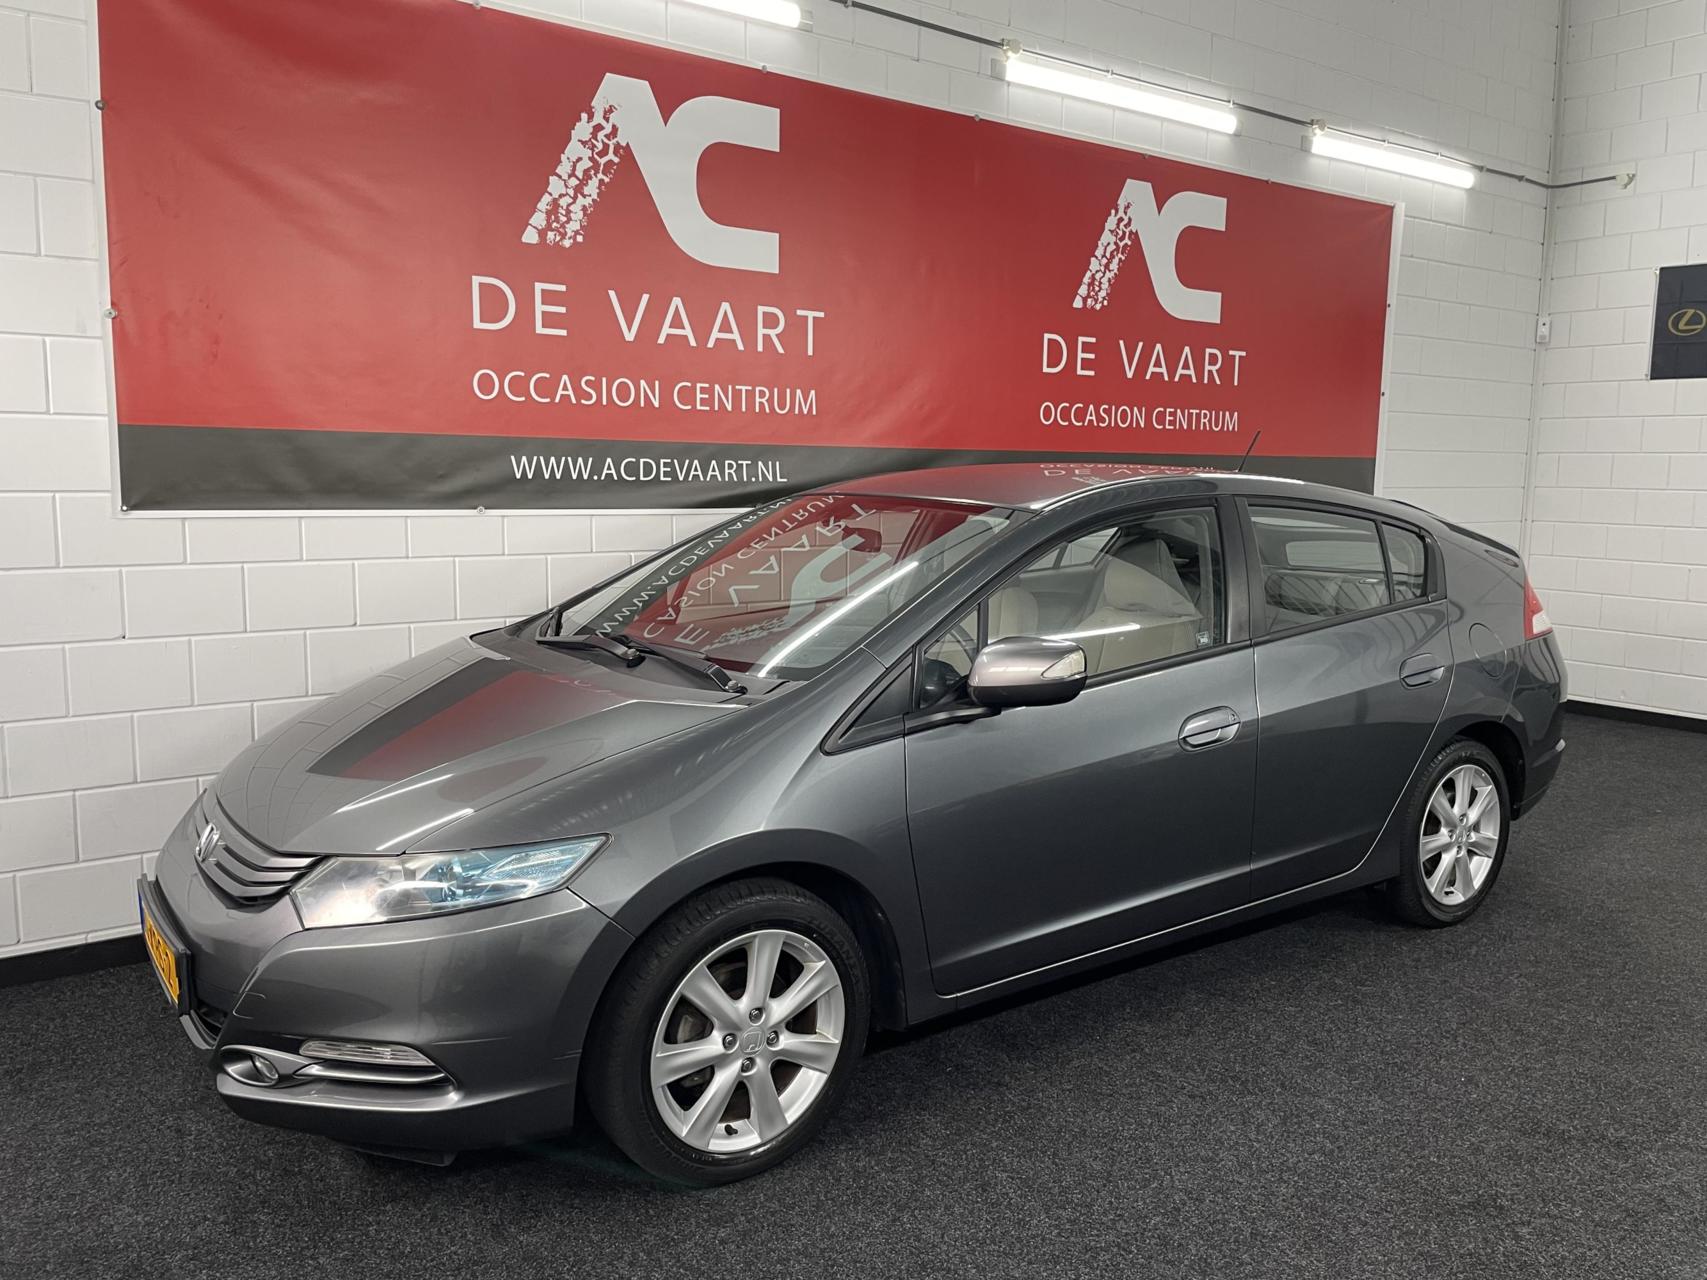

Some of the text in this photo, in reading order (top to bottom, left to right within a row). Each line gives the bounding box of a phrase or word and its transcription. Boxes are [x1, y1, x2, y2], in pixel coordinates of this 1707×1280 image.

[520, 72, 781, 274] AC
[1072, 178, 1228, 324] AC
[471, 275, 825, 356] DE VAART
[1042, 332, 1247, 386] DE VAART
[472, 368, 818, 416] OCCASION CENTRUM
[1039, 401, 1239, 432] OCCASION CENTRUM
[510, 454, 788, 483] WWW.ACDEVAART.NL
